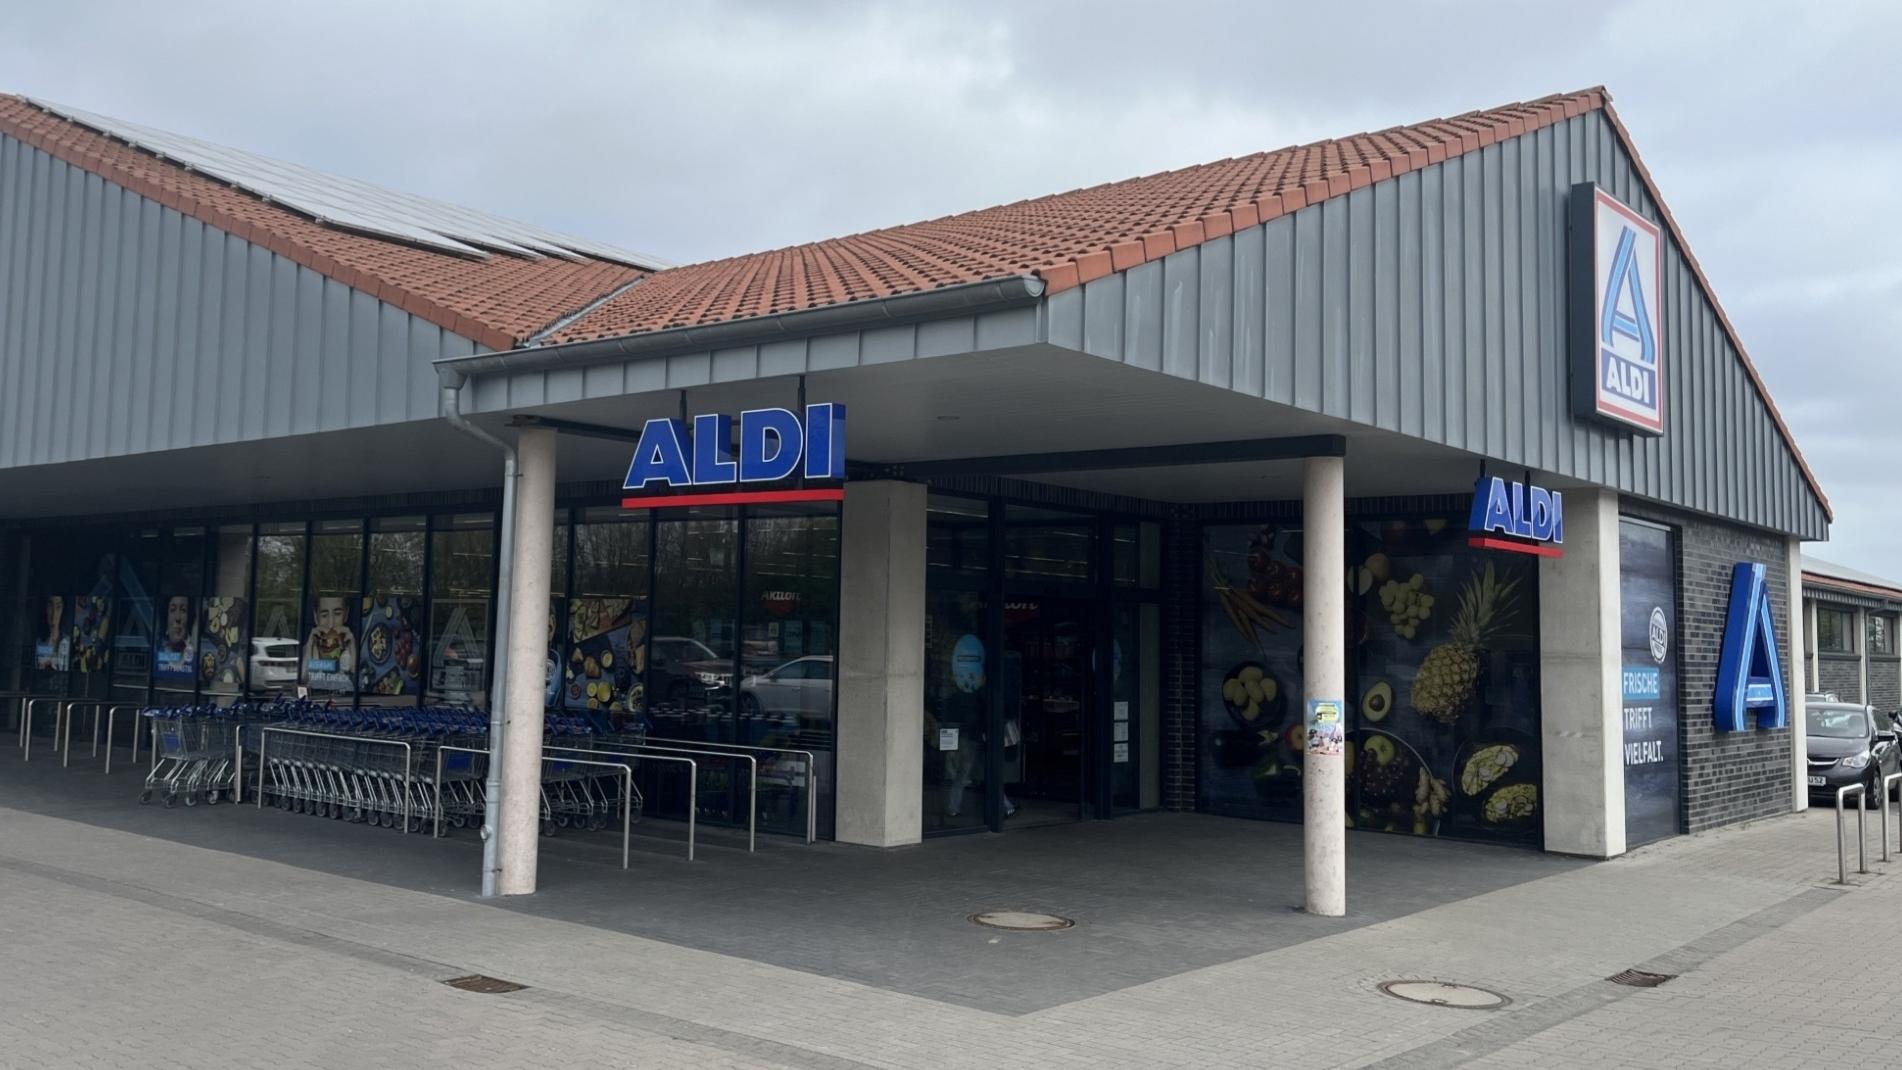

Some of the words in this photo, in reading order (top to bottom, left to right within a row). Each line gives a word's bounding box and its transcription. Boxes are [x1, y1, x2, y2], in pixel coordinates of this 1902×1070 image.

[1606, 357, 1651, 403] ALDI
[623, 403, 836, 489] ALDI
[1484, 476, 1563, 543] ALDI
[1623, 672, 1658, 694] FRISCHE
[1624, 707, 1652, 730] TRIFFT
[1625, 741, 1663, 765] VIELFALT.
